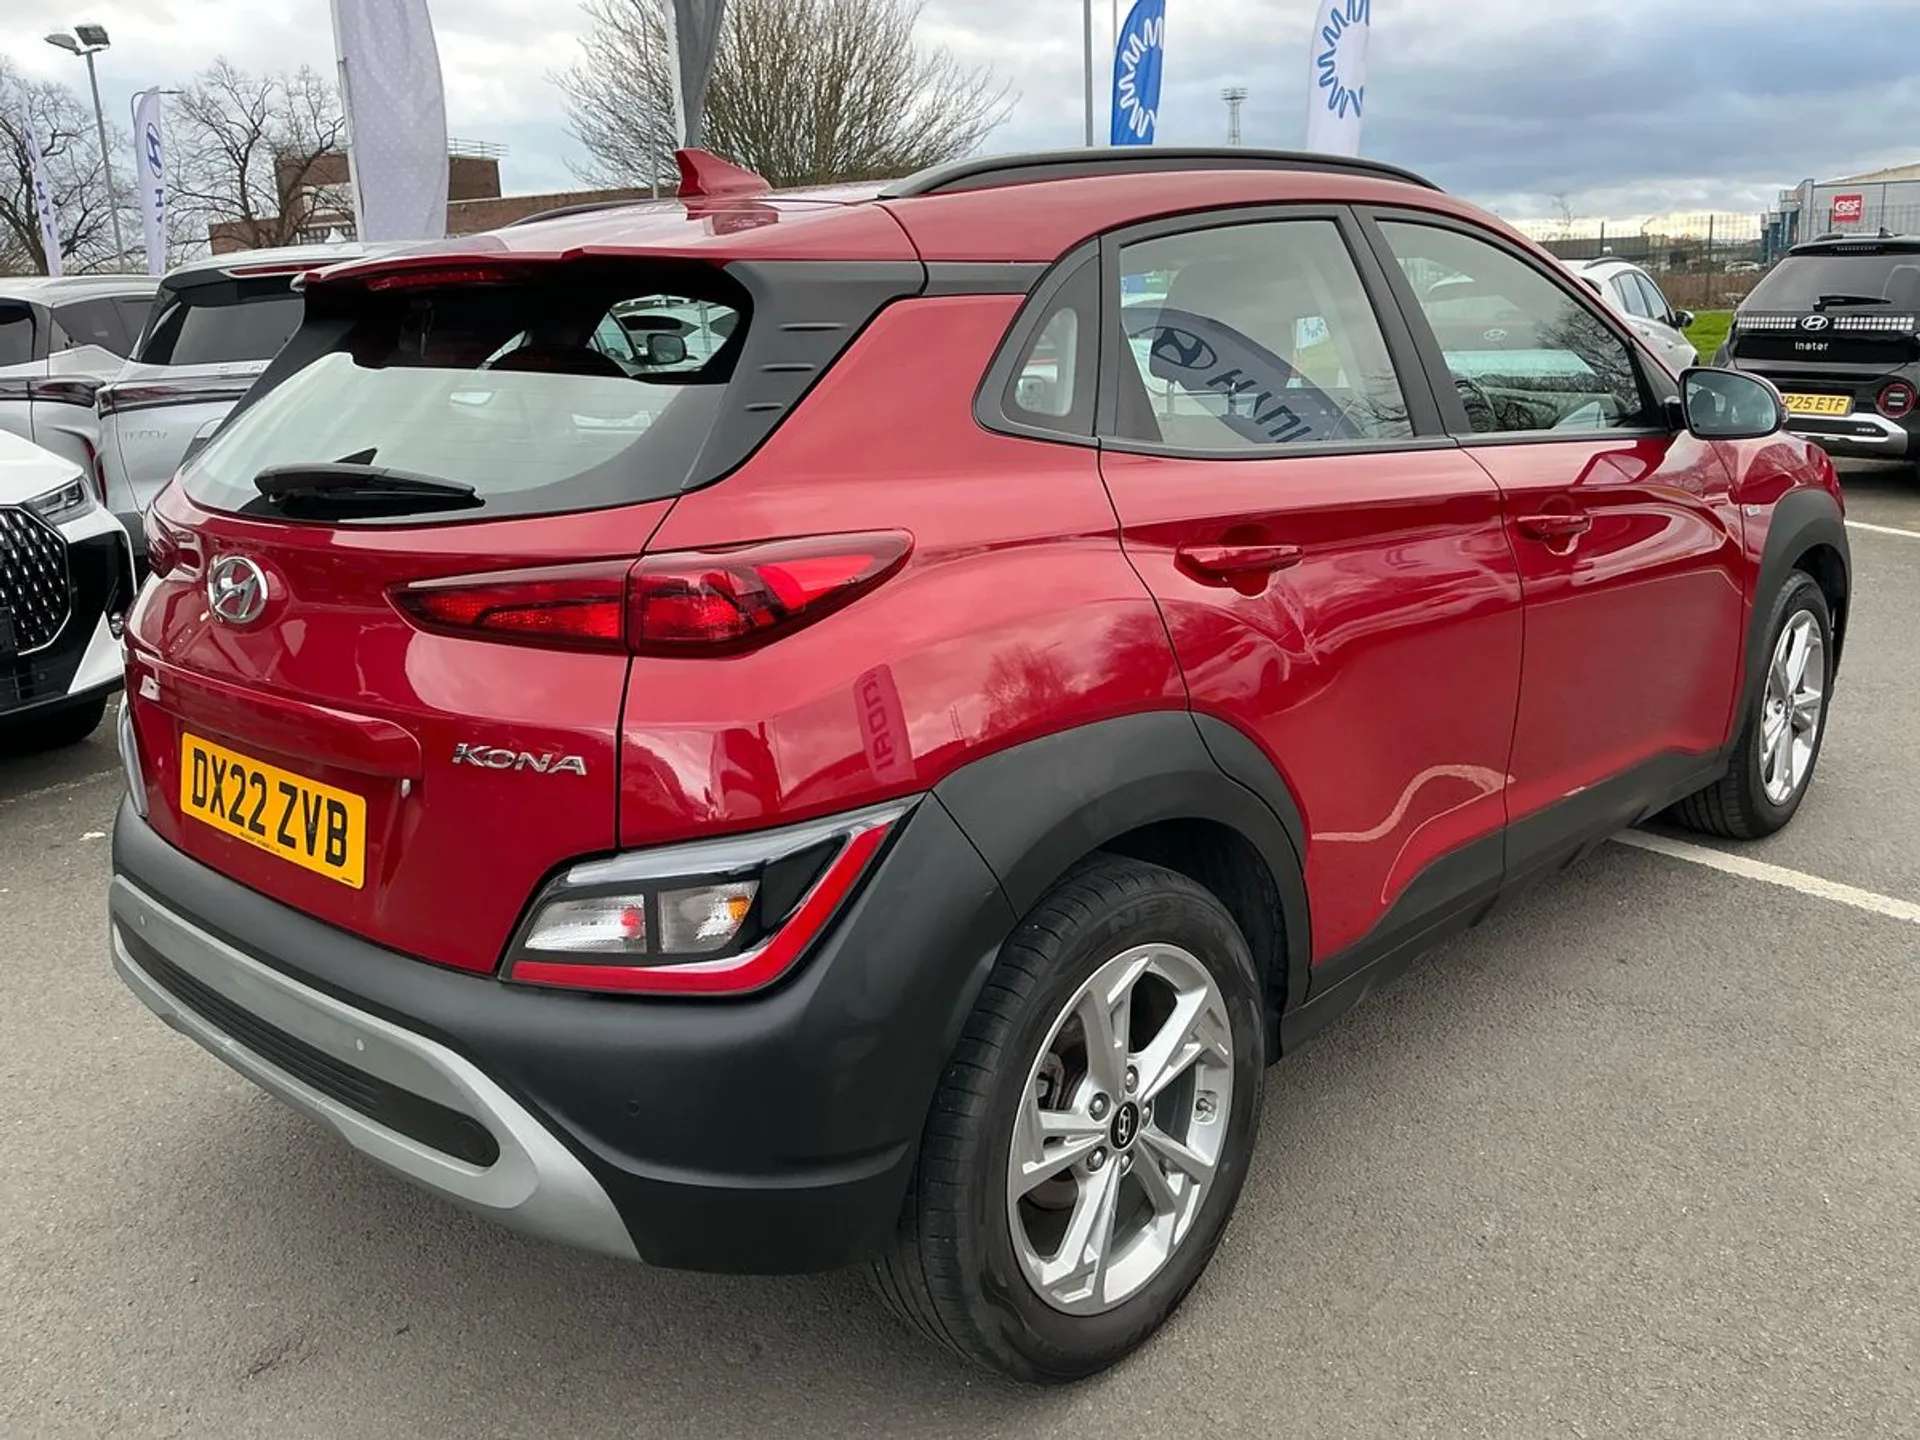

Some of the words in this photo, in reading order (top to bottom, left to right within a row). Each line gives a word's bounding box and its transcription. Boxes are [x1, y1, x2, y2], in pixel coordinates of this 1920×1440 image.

[1781, 396, 1814, 411] P25
[1815, 397, 1847, 411] ETF
[452, 742, 587, 776] KONA
[191, 747, 267, 836] DX22
[277, 780, 348, 867] ZVB
